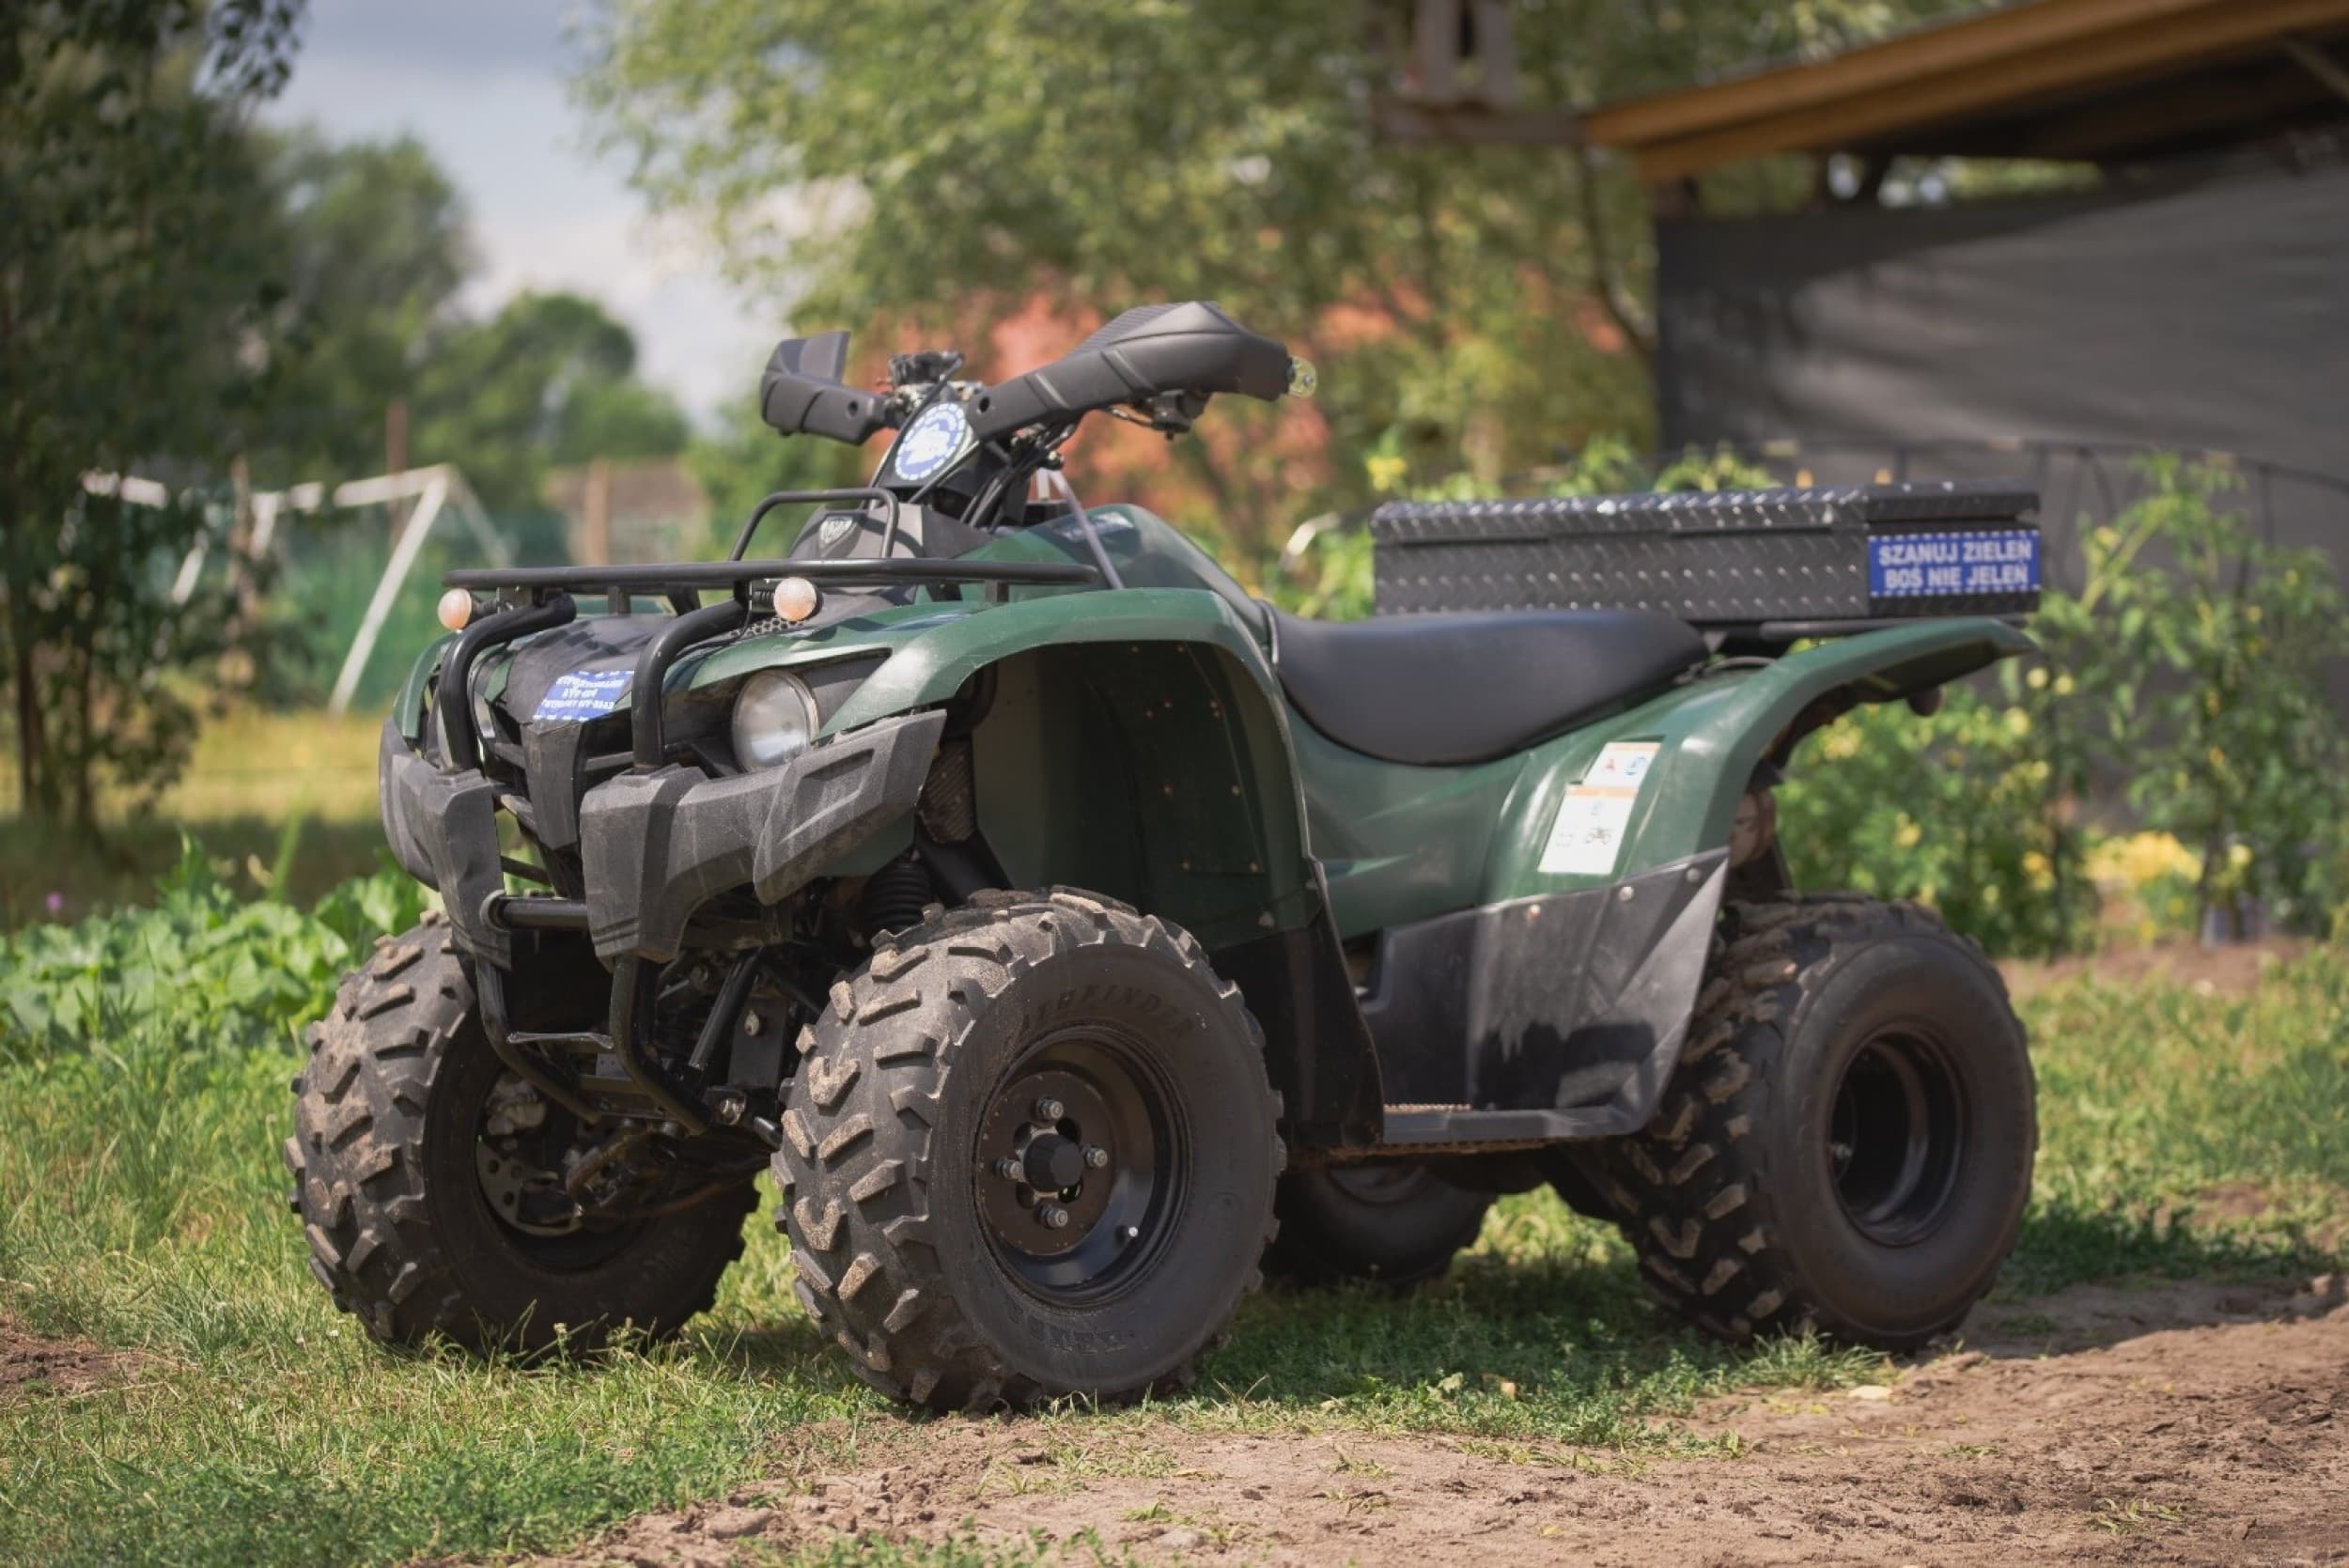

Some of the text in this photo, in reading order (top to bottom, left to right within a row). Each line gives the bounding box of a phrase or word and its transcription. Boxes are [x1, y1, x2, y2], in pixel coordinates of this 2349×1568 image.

[1879, 542, 1958, 566] SZANUJ
[1885, 566, 1923, 589] BOŚ
[1927, 567, 1962, 586] NIE
